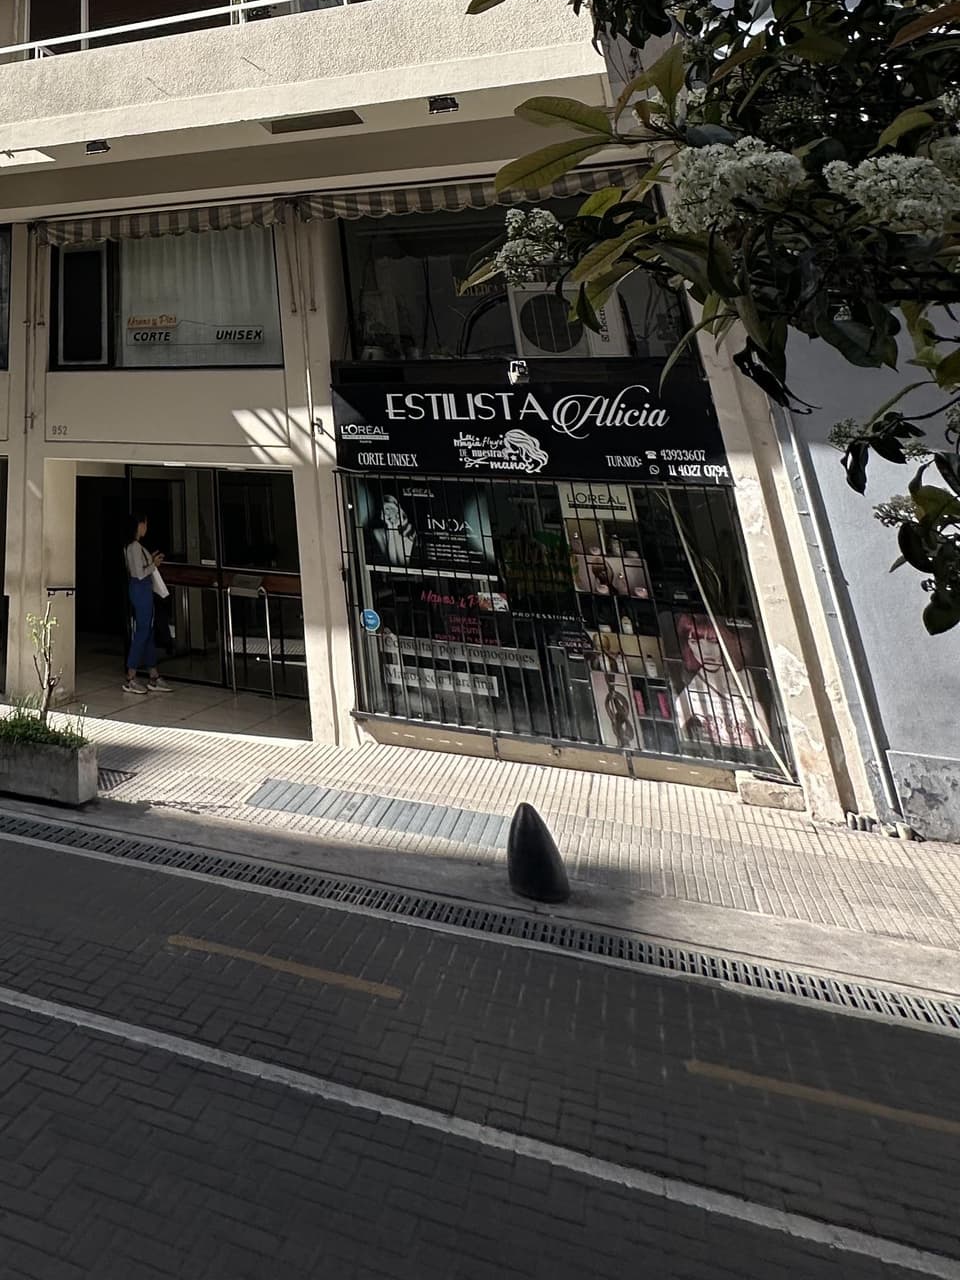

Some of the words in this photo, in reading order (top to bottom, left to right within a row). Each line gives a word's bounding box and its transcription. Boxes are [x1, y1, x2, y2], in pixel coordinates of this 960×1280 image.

[134, 331, 171, 342] CORTE
[216, 329, 262, 341] UNISEX
[385, 392, 550, 421] ESTILISTA
[551, 384, 670, 440] Alicia
[357, 452, 386, 466] CORTE
[386, 453, 418, 467] UNISEX
[606, 455, 642, 467] TURNOS:
[660, 449, 705, 461] 43933607
[677, 465, 701, 477] 4027
[703, 465, 729, 478] 0794
[567, 492, 626, 506] LOREAL
[512, 611, 588, 623] PROESSIONNL
[439, 644, 457, 656] por
